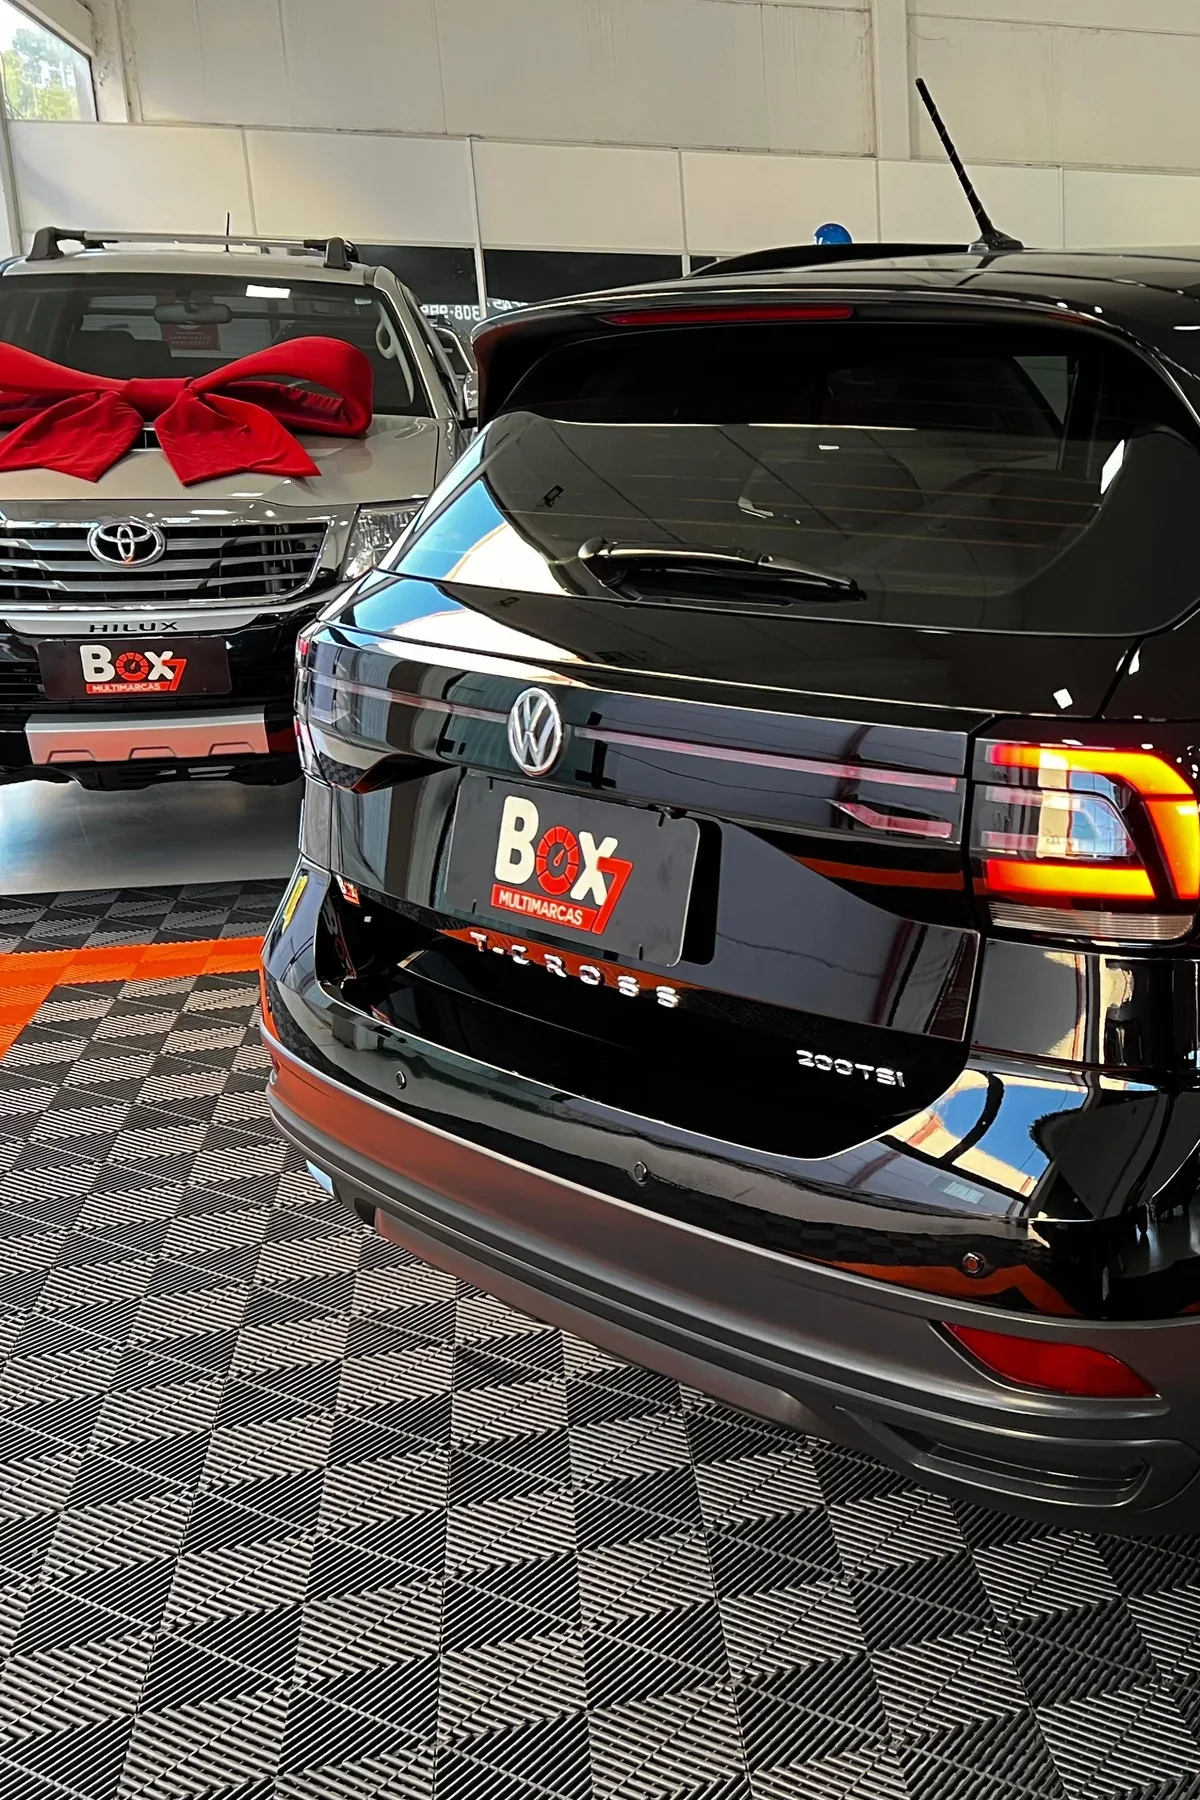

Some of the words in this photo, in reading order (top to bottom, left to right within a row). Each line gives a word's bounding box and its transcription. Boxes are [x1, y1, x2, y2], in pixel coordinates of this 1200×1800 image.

[89, 621, 178, 633] HILUX
[92, 682, 161, 692] MULTIMARCAS
[499, 889, 583, 926] MULTIMARCAS
[469, 931, 681, 1008] T-CROSS
[796, 1049, 905, 1088] 200TSI
